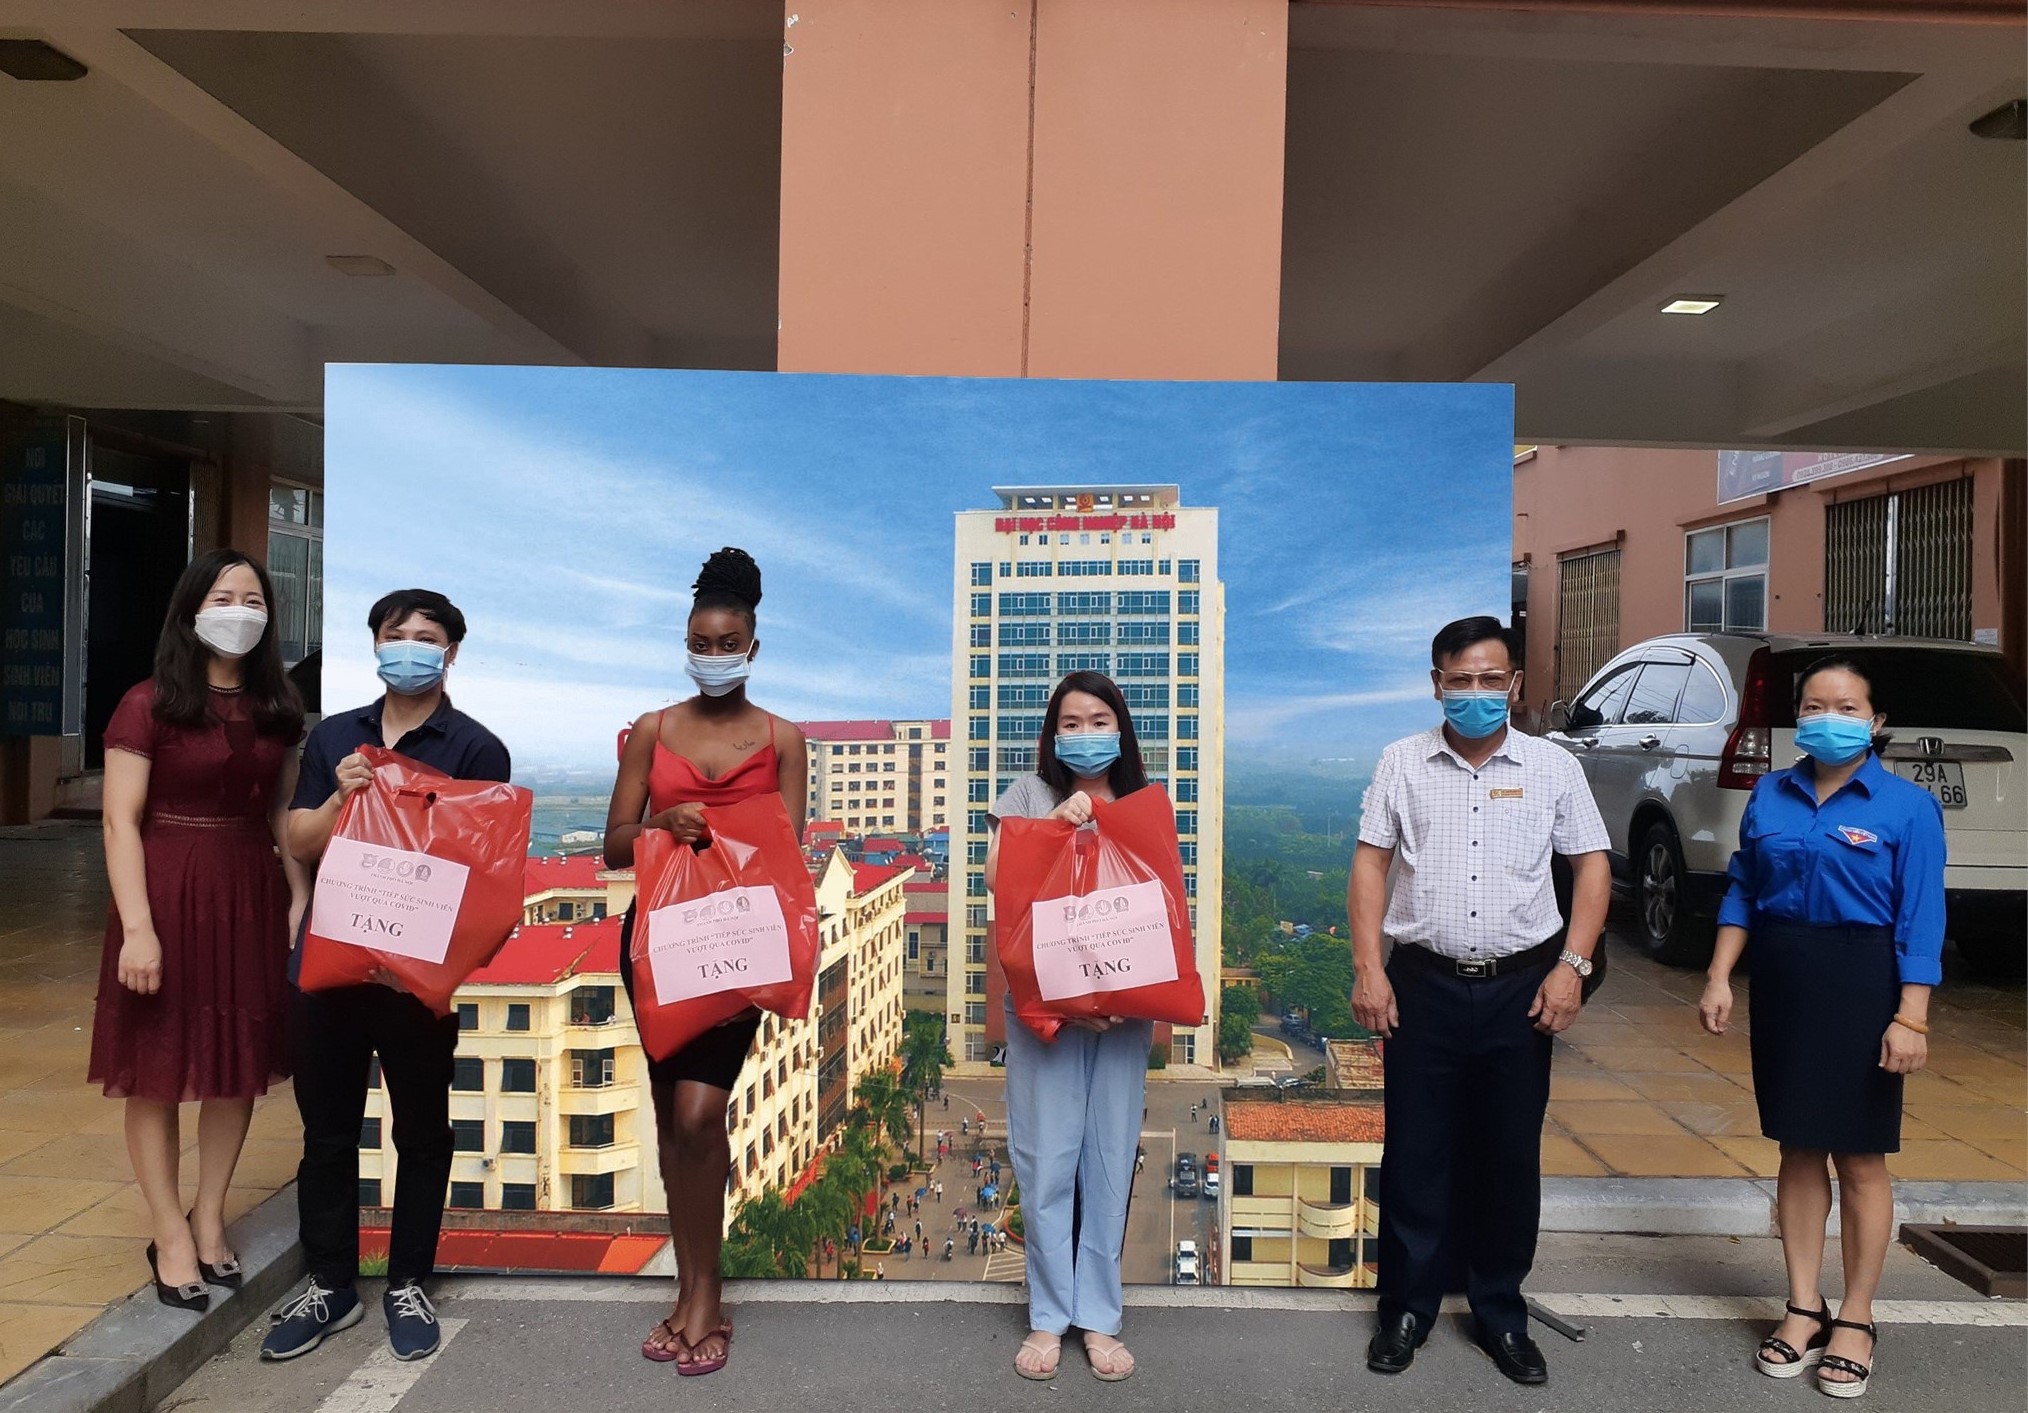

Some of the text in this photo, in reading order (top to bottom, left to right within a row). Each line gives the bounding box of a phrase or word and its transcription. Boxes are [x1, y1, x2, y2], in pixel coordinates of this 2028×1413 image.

[1912, 763, 1947, 782] 29A
[416, 897, 435, 908] SINH
[351, 912, 404, 937] TẶNG
[749, 925, 765, 935] SINH
[1128, 924, 1147, 934] SINH
[697, 957, 748, 979] TẶNG
[1079, 957, 1131, 980] TẶNG
